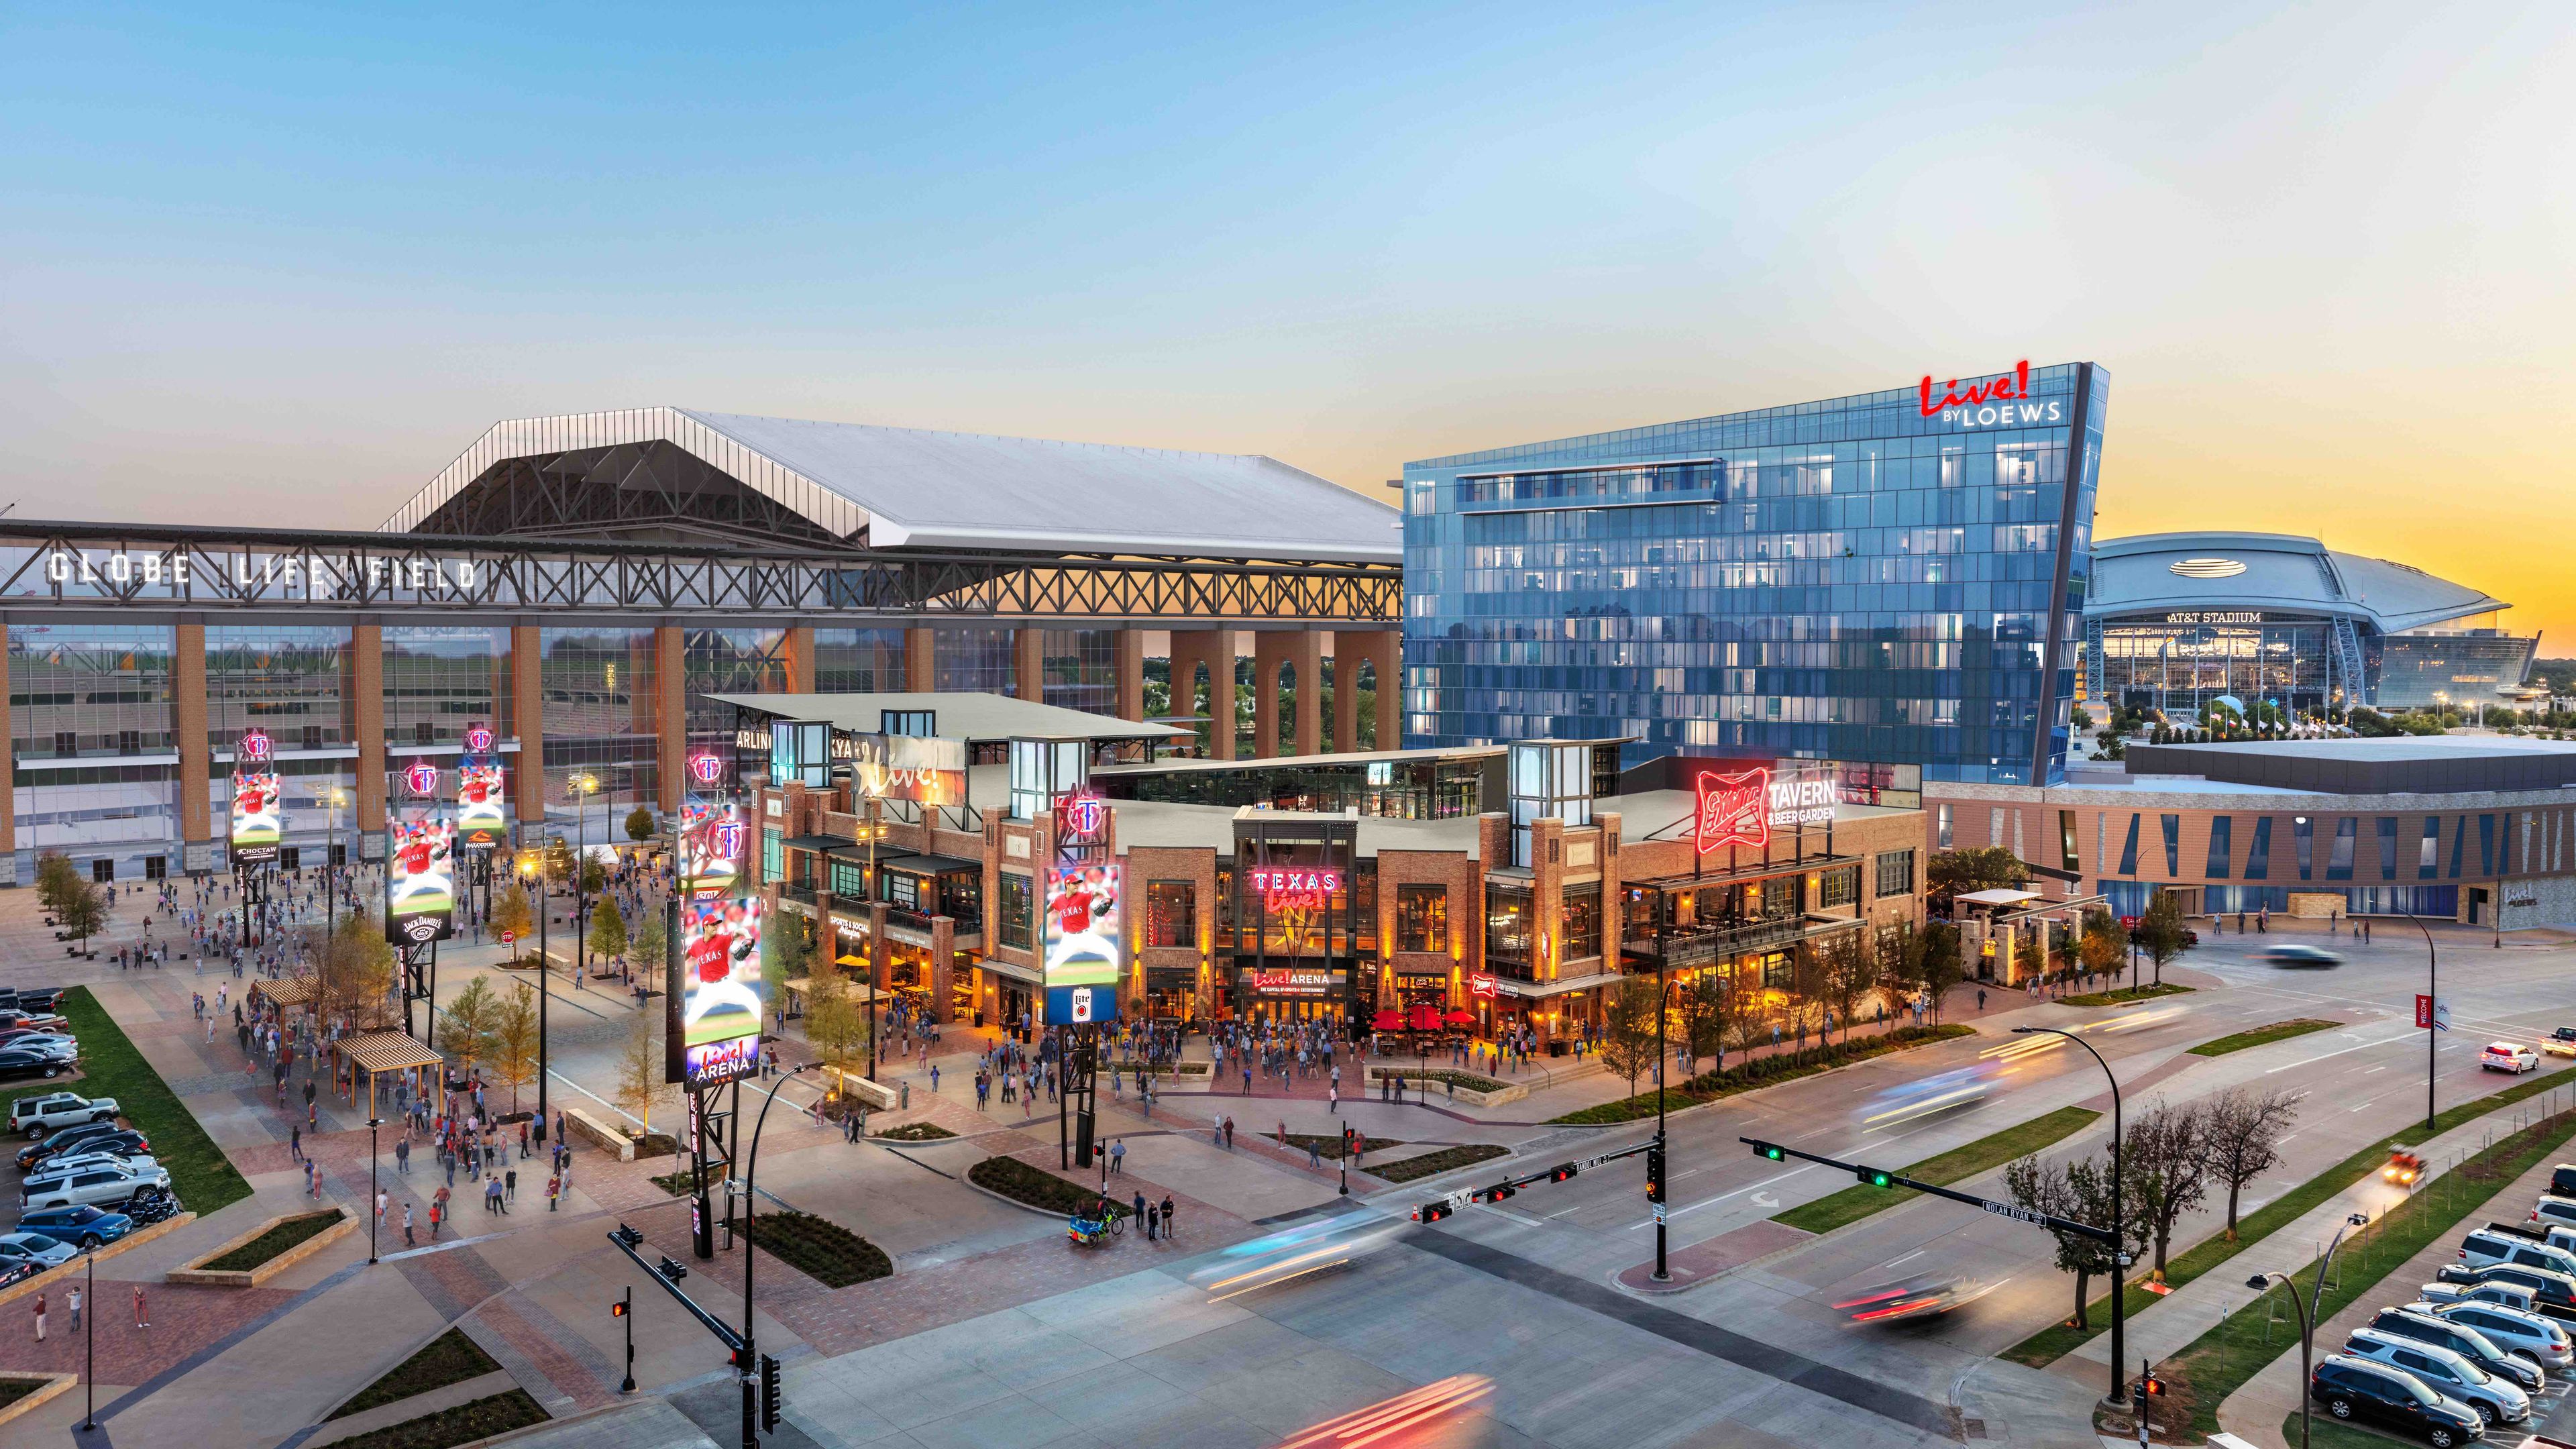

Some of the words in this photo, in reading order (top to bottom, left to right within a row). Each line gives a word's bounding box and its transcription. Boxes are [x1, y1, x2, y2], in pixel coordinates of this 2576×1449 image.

[1920, 360, 2029, 417] Live!
[1943, 410, 1960, 422] BY
[1964, 402, 2060, 427] LOEWS
[50, 553, 189, 582] GLOBE
[238, 557, 324, 585] LIFE
[369, 560, 475, 588] FIELD
[2168, 612, 2200, 623] AT&T
[2203, 612, 2261, 623] STADIUM
[872, 741, 938, 796] Live!
[1769, 780, 1835, 810] TAVERN
[1767, 812, 1775, 826] &
[1775, 810, 1798, 825] BEER
[1799, 807, 1835, 822] GARDEN
[241, 847, 276, 855] CHOCTAW
[1254, 873, 1335, 890] TEXAS
[1268, 886, 1323, 912] Live!
[404, 919, 419, 932] JACK
[419, 916, 442, 930] DANIEL'S
[852, 922, 869, 933] SOCIAL
[1254, 970, 1289, 987] Live!
[1290, 974, 1330, 984] ARENA
[1075, 995, 1089, 1005] Lite
[703, 1040, 743, 1071] Live!
[696, 1057, 750, 1082] ARENA
[1576, 1161, 1592, 1171] RANDOL
[1593, 1157, 1602, 1167] MILL
[1654, 1205, 1665, 1213] YIELD
[1986, 1203, 2008, 1216] NOLAN
[2010, 1209, 2029, 1221] RYAN
